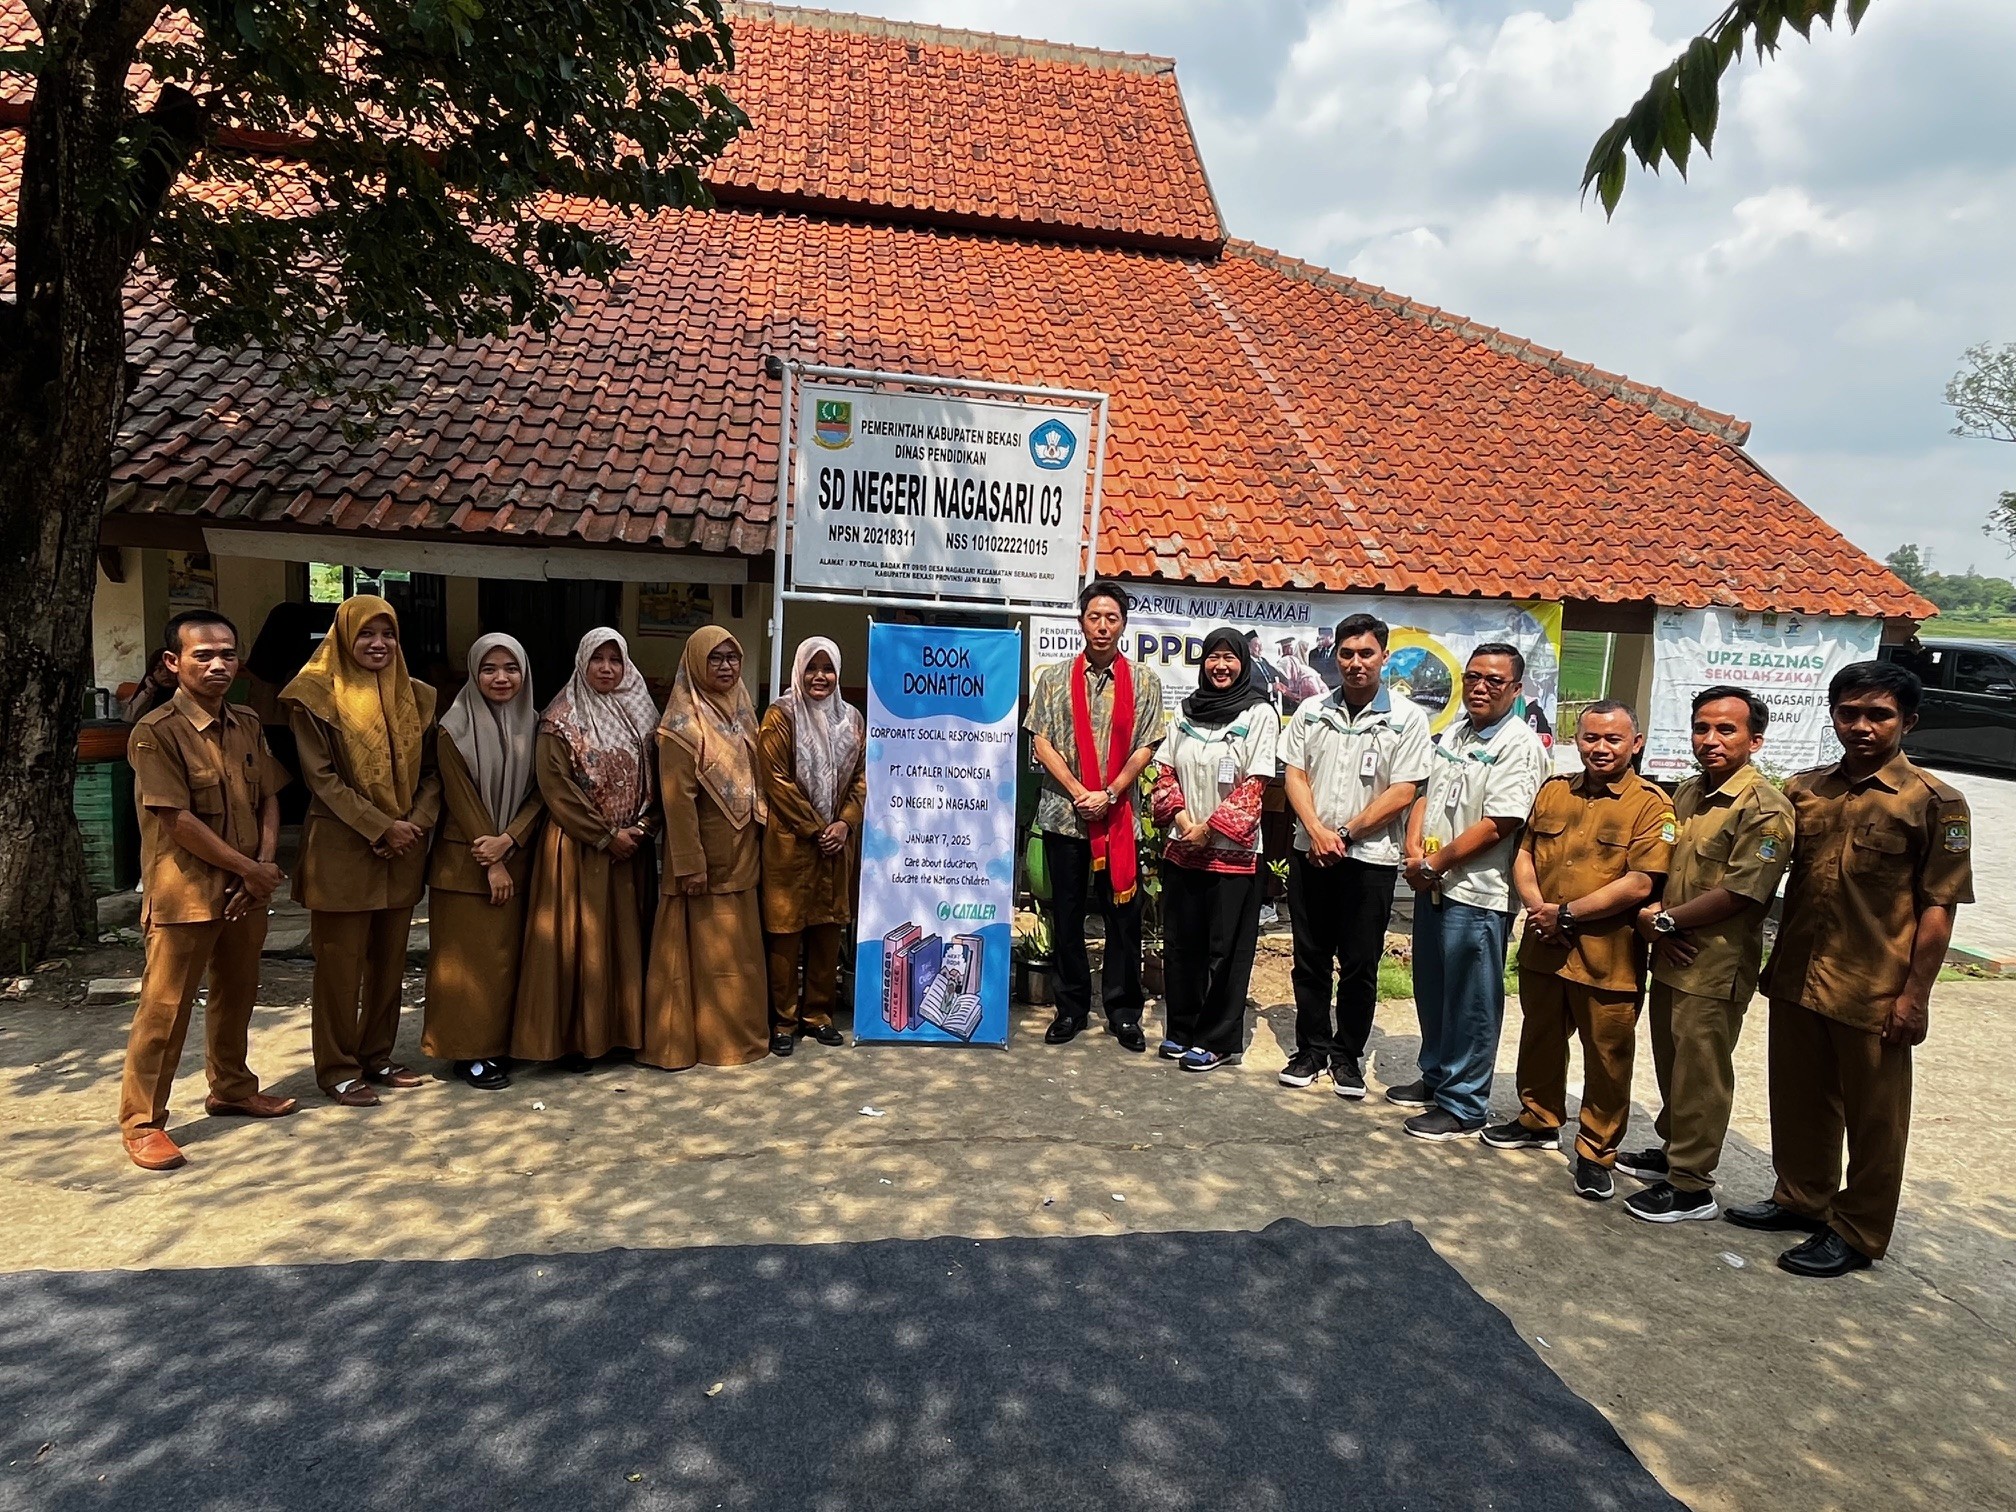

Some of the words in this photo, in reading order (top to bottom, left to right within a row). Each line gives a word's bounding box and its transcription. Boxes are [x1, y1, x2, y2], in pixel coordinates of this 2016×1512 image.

[861, 420, 924, 439] PEMERINTAH
[927, 425, 984, 444] KABUPATEN
[987, 431, 1022, 447] BEKASI
[895, 445, 925, 460] DINAS
[928, 447, 987, 465] PENDIDIKAN
[818, 467, 845, 510] SD
[852, 470, 927, 516] NEGERI
[934, 476, 1034, 524] NAGASARI
[1040, 485, 1062, 527] 03
[828, 524, 860, 543] NPSN
[863, 527, 916, 546] 20218311
[946, 533, 968, 550] NSS
[972, 534, 1048, 555] 101022221015
[819, 558, 844, 567] ALAMAT
[859, 560, 878, 568] TEGAL
[880, 561, 900, 570] BADAK
[929, 565, 944, 573] DESA
[945, 566, 976, 575] NAGASARI
[977, 568, 1013, 577] KECAMATAN
[1014, 571, 1038, 579] SERANG
[1039, 572, 1055, 580] BARU
[874, 570, 911, 579] KABUPATEN
[912, 572, 934, 580] BEKASI
[935, 573, 963, 582] PROVINSI
[964, 576, 981, 584] JAWA
[1127, 595, 1184, 615] DARUL
[922, 646, 970, 669] BOOK
[1136, 632, 1204, 667] PPD
[1706, 651, 1743, 665] UPZ
[1749, 653, 1824, 669] BAZNAS
[904, 672, 984, 697] DONATION
[1705, 668, 1771, 681] SEKOLAH
[1774, 672, 1822, 683] ZAKAT
[1770, 712, 1801, 723] BARU
[870, 727, 915, 740] CORPORATE
[917, 728, 946, 741] SOCIAL
[948, 730, 1014, 743] RESPONSIBILITY
[889, 764, 904, 777] PT.
[906, 765, 942, 778] CATALER
[945, 766, 991, 780] INDONESIA
[890, 795, 903, 808] SD
[905, 795, 935, 809] NEGERI
[937, 797, 943, 810] 3
[945, 798, 988, 811] NAGASARI
[905, 832, 940, 844] JANUARY
[942, 834, 949, 847] 7,
[951, 835, 971, 846] 2025
[904, 857, 920, 867] Care
[921, 857, 942, 868] about
[892, 872, 919, 884] Educate
[920, 873, 932, 884] the
[933, 874, 960, 885] Nations
[961, 874, 990, 886] Children
[952, 904, 997, 920] CATALER
